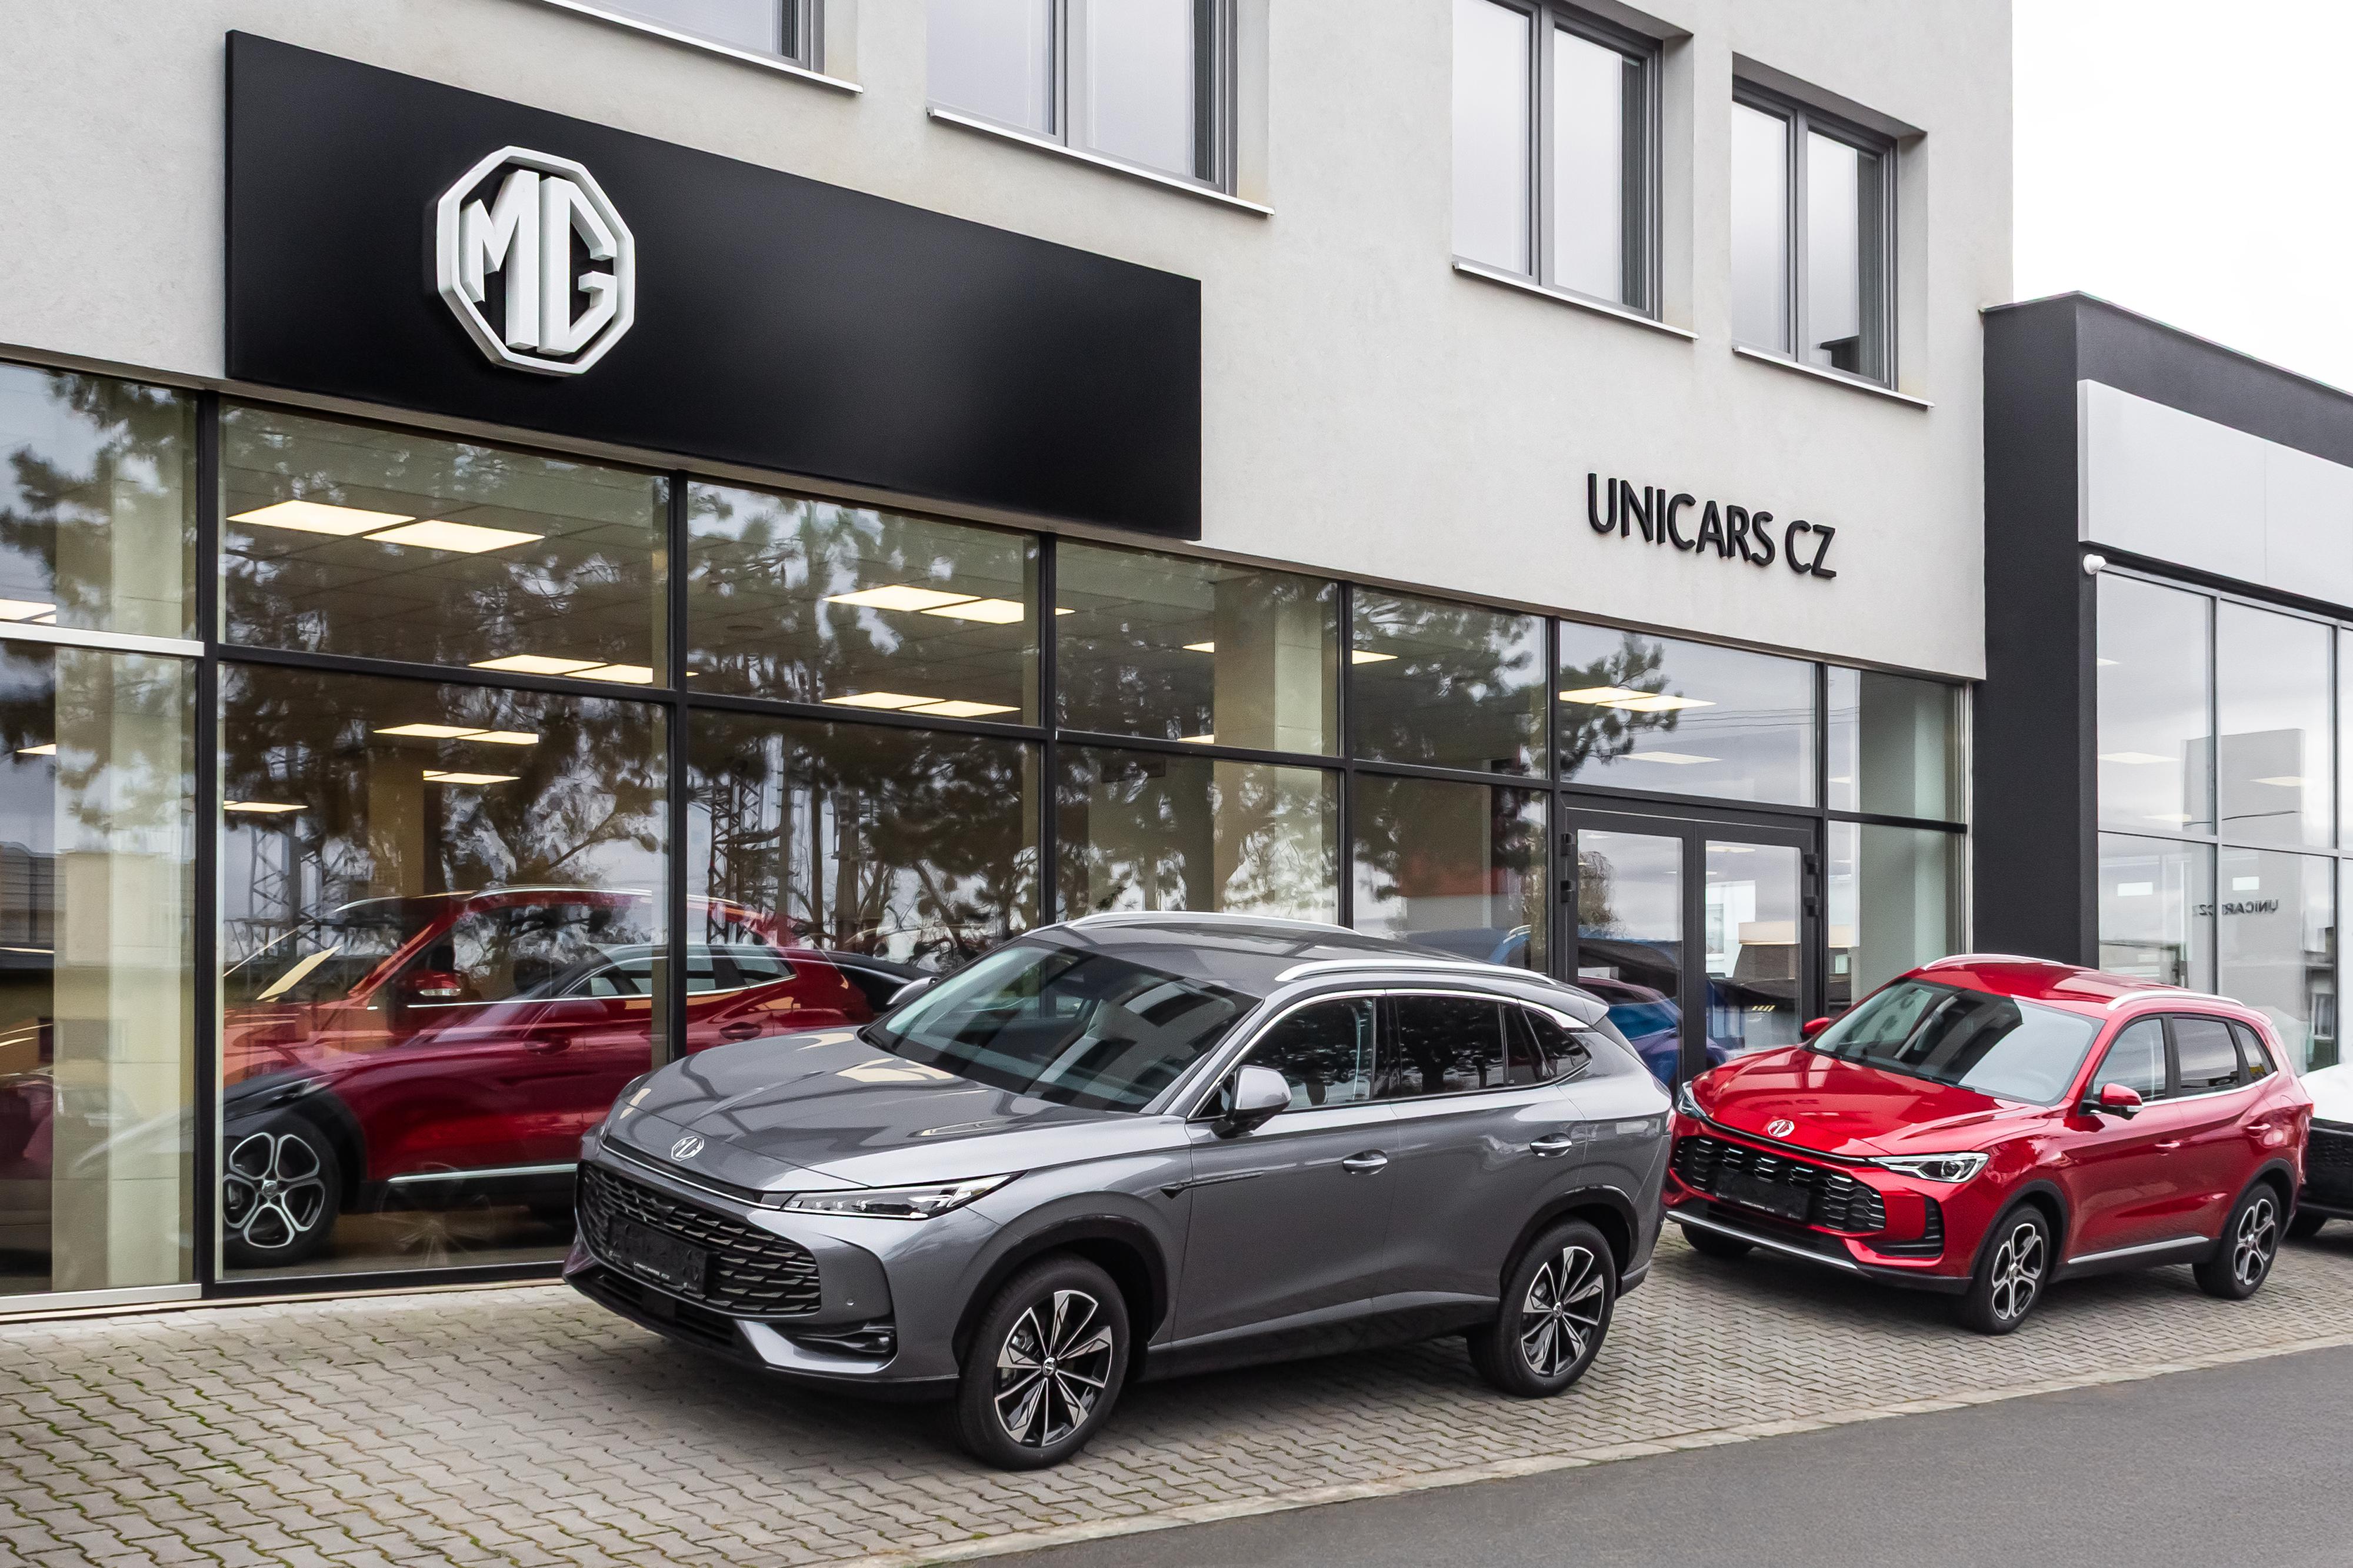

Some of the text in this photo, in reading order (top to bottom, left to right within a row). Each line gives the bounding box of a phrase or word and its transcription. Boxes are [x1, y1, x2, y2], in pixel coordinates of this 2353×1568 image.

[460, 169, 617, 355] MG
[1588, 473, 1837, 579] UNICARS CZ
[675, 1137, 702, 1158] MG
